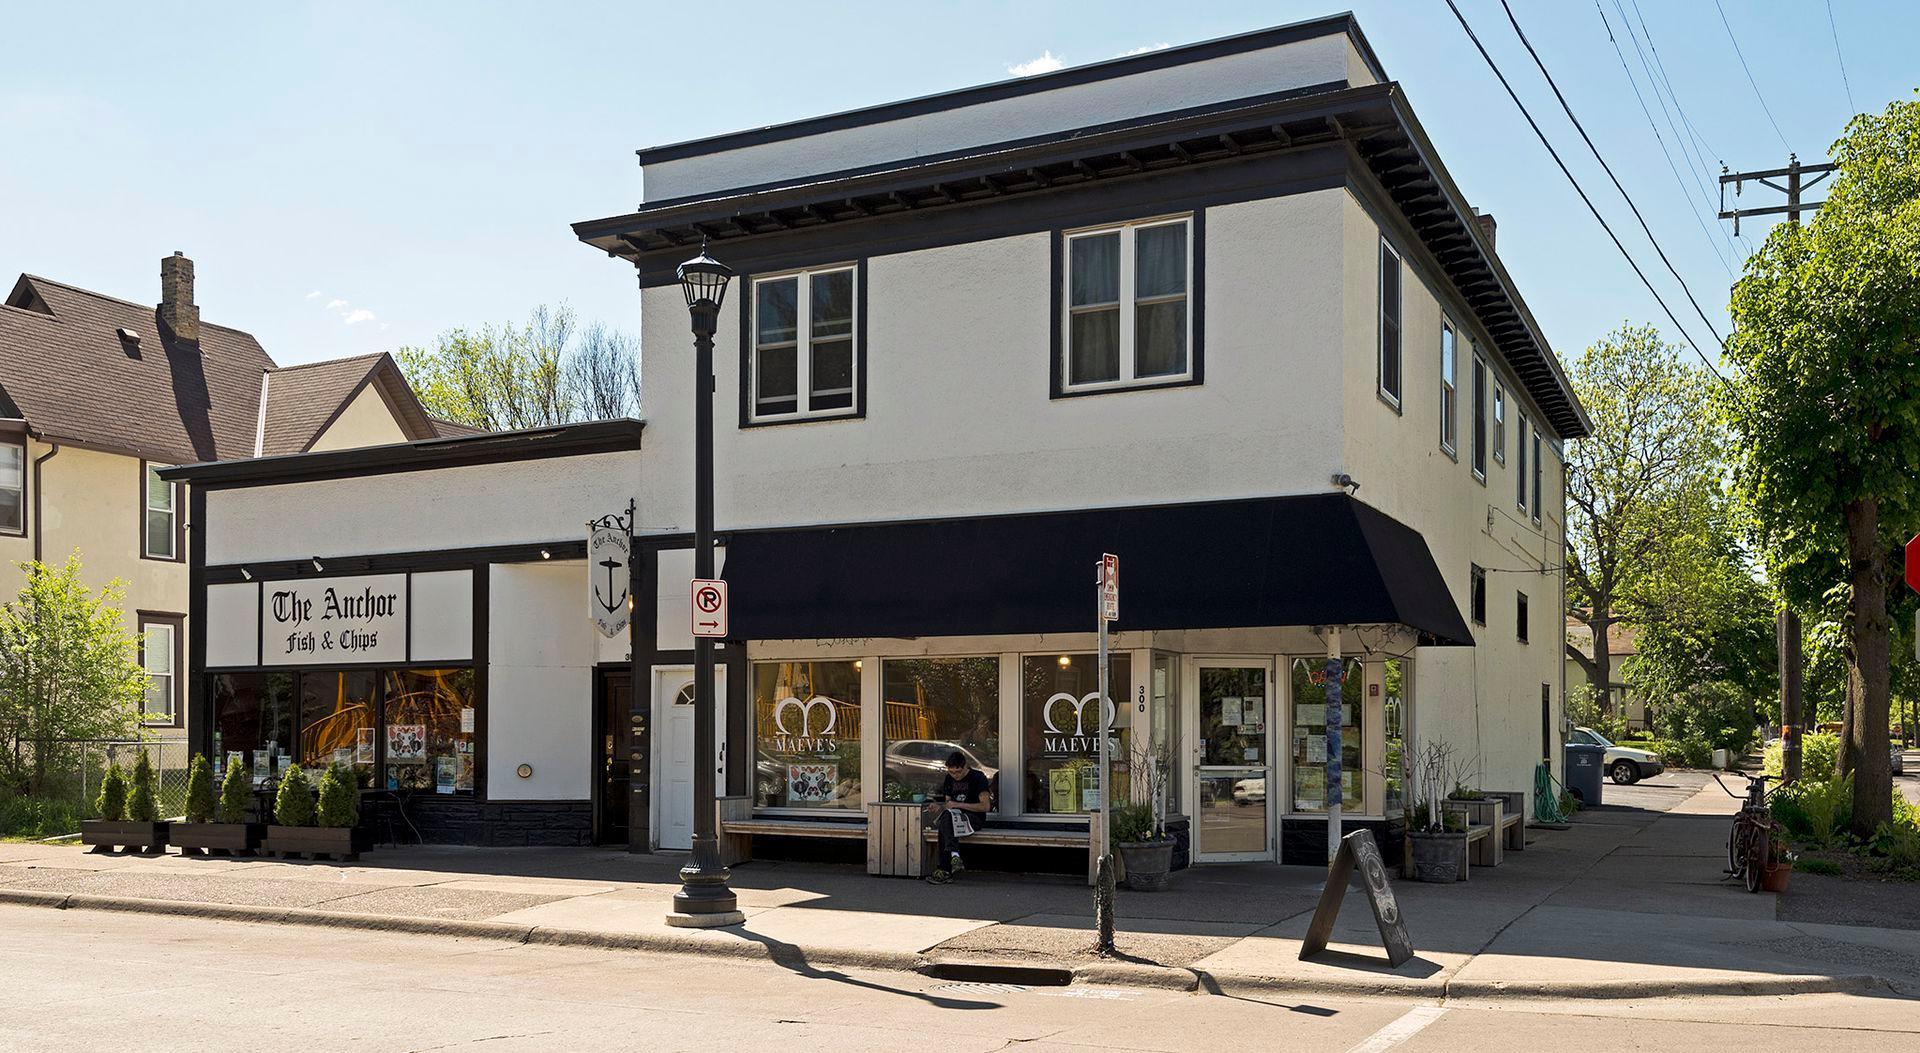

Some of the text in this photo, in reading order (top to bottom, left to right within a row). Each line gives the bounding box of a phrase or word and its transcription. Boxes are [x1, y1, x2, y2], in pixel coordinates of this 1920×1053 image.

[271, 586, 397, 628] The Anchor
[285, 628, 379, 655] Fish & Chips
[775, 738, 837, 752] MAEVE'S
[1044, 738, 1116, 752] MAEVES
